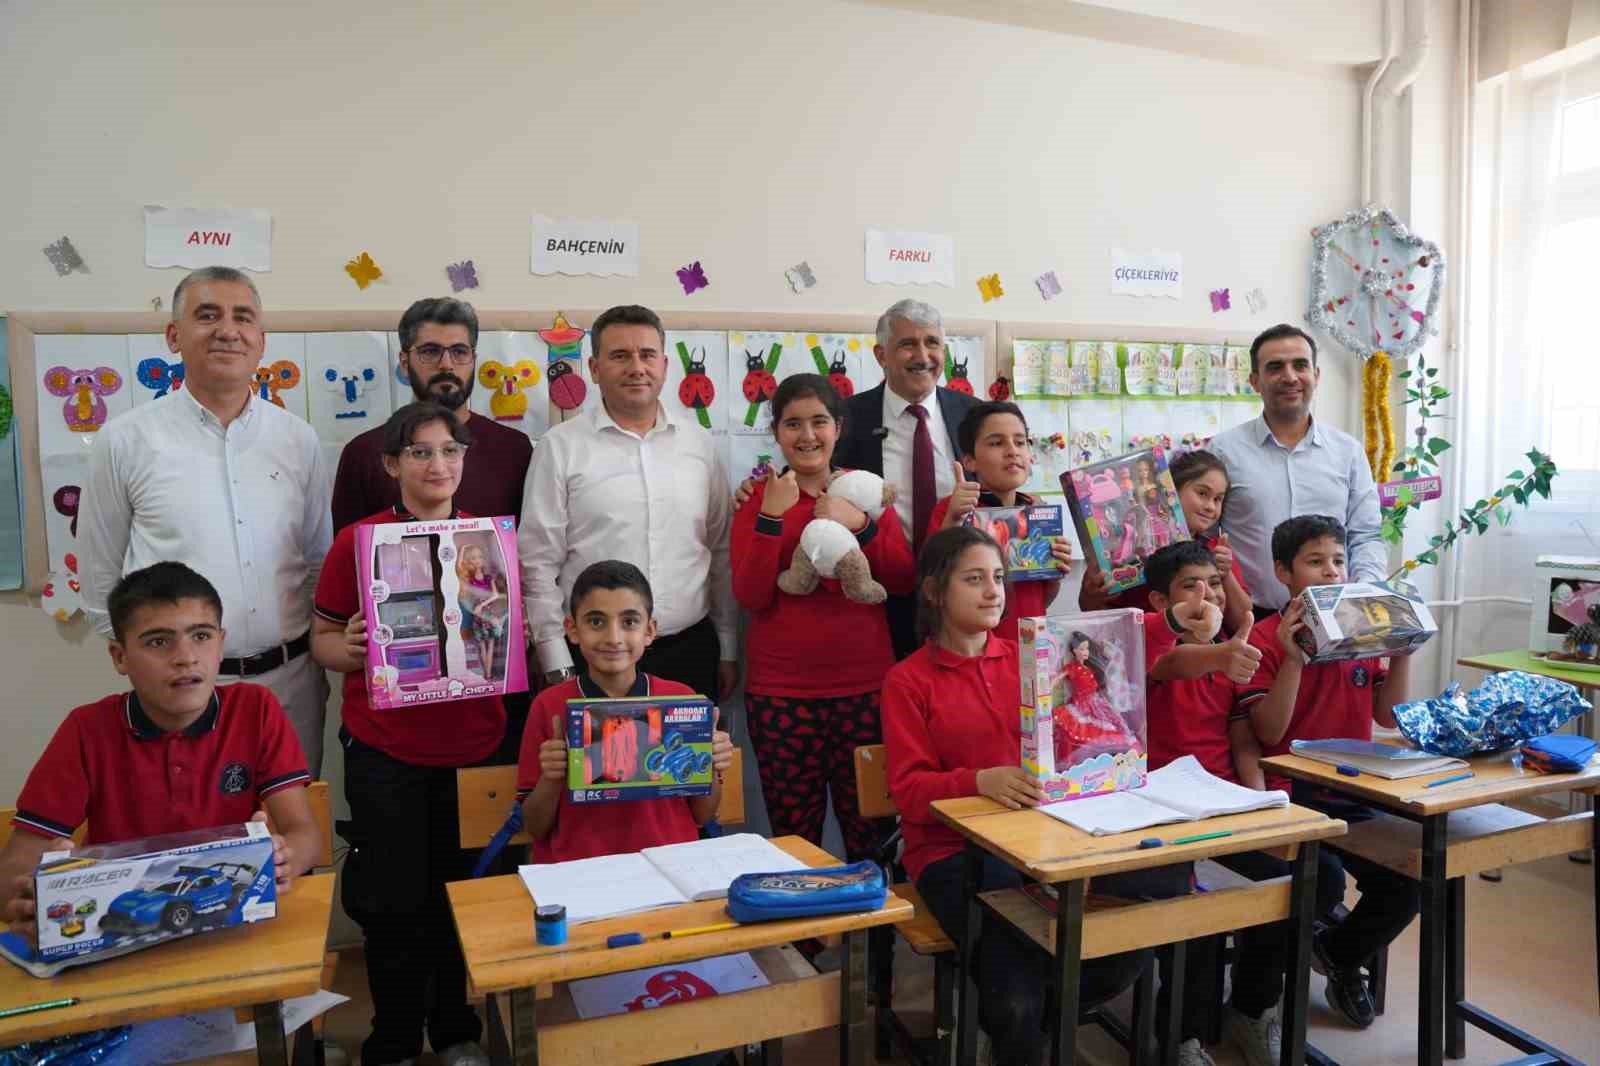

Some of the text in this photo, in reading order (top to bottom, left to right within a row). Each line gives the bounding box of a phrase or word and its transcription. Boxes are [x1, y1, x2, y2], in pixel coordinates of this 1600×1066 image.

[187, 231, 231, 246] AYNI
[546, 238, 624, 255] BAHÇENİN
[889, 249, 931, 263] FARKLI
[1115, 266, 1179, 282] ÇİÇEKLERİYİZ
[406, 524, 426, 533] Let's
[428, 523, 448, 532] make
[403, 685, 494, 703] MY LITTLE CHEF'S
[67, 868, 132, 887] RACER
